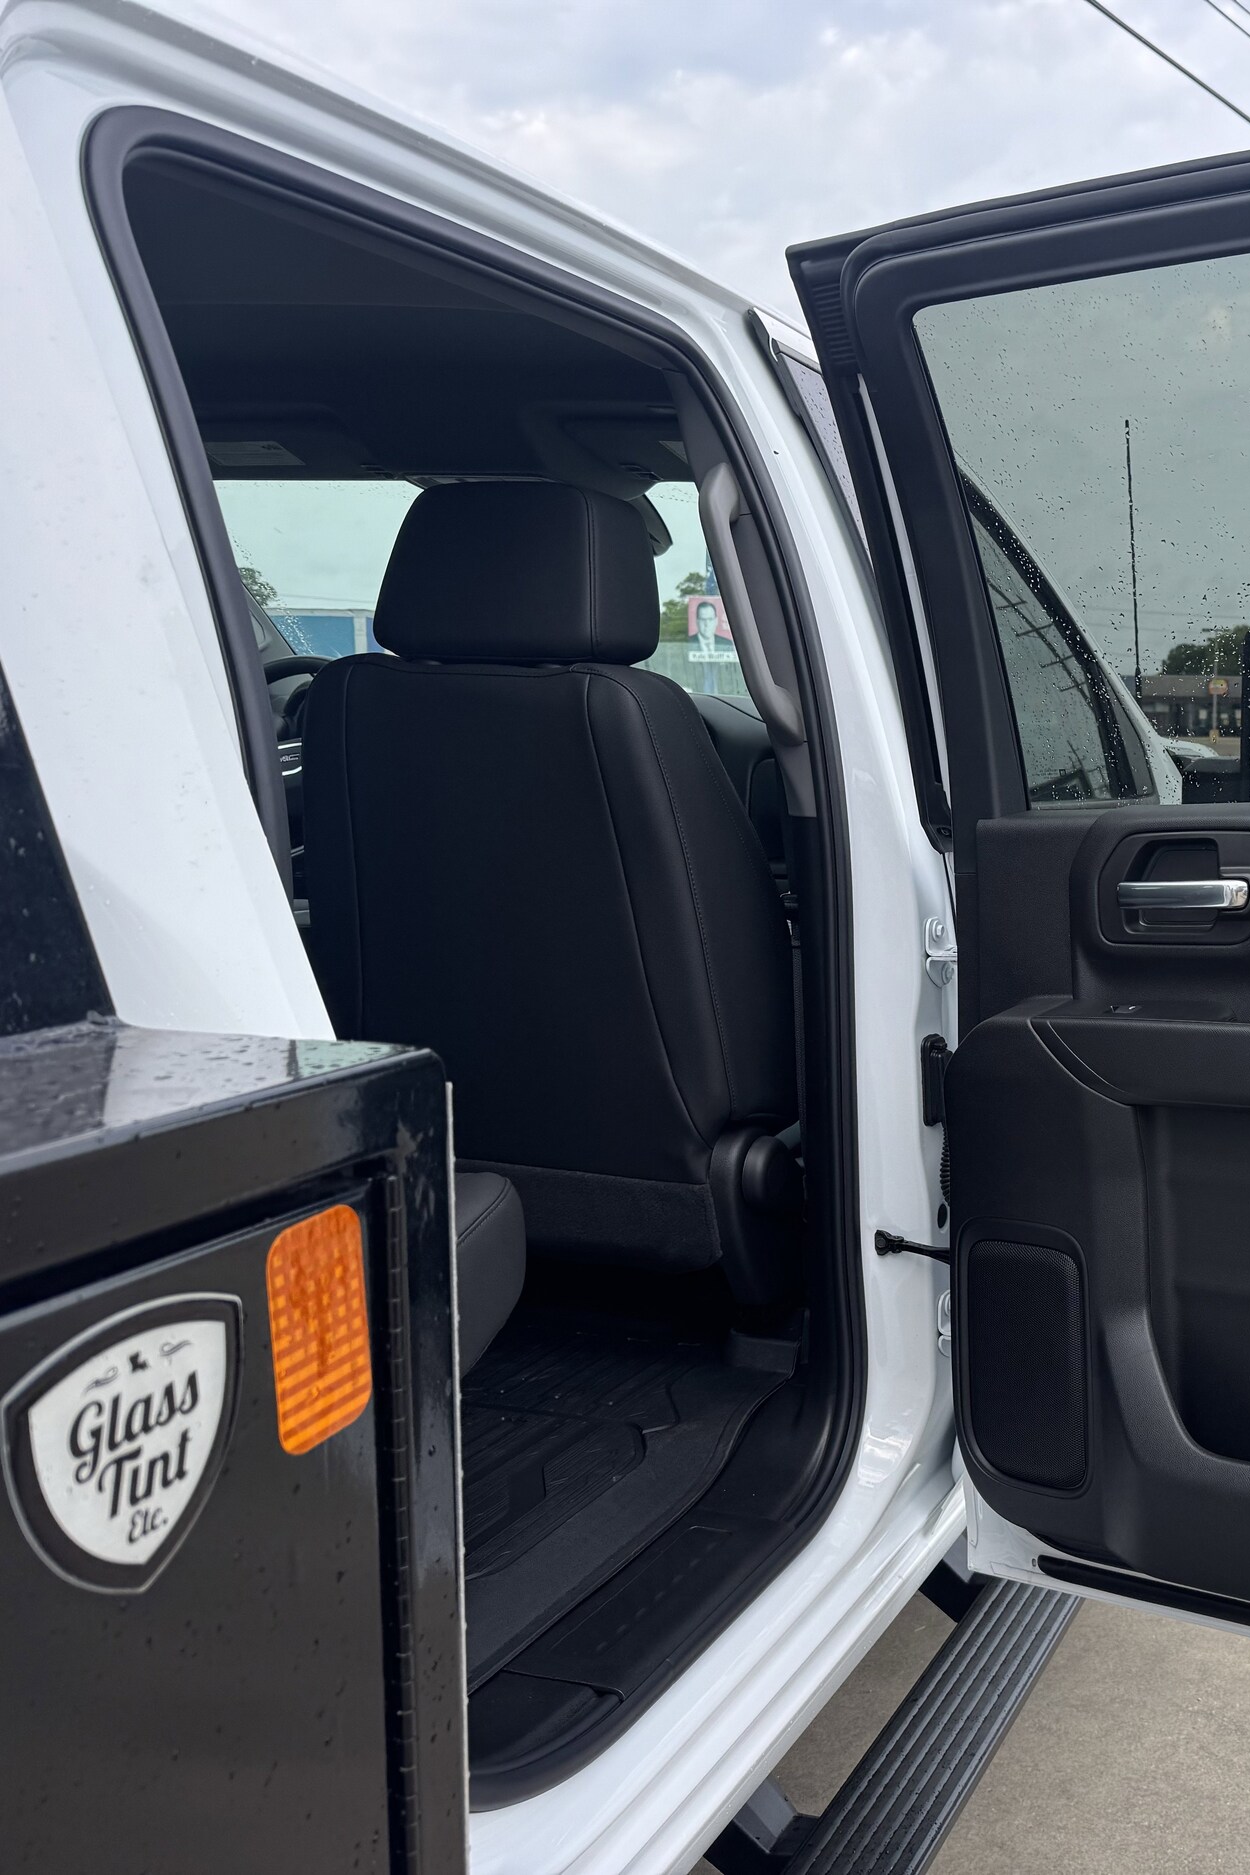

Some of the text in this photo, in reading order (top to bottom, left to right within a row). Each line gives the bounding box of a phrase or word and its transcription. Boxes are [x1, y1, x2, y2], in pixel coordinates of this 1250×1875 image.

[69, 1370, 199, 1484] Glass
[98, 1428, 190, 1519] Tint
[128, 1508, 168, 1544] Etc.
